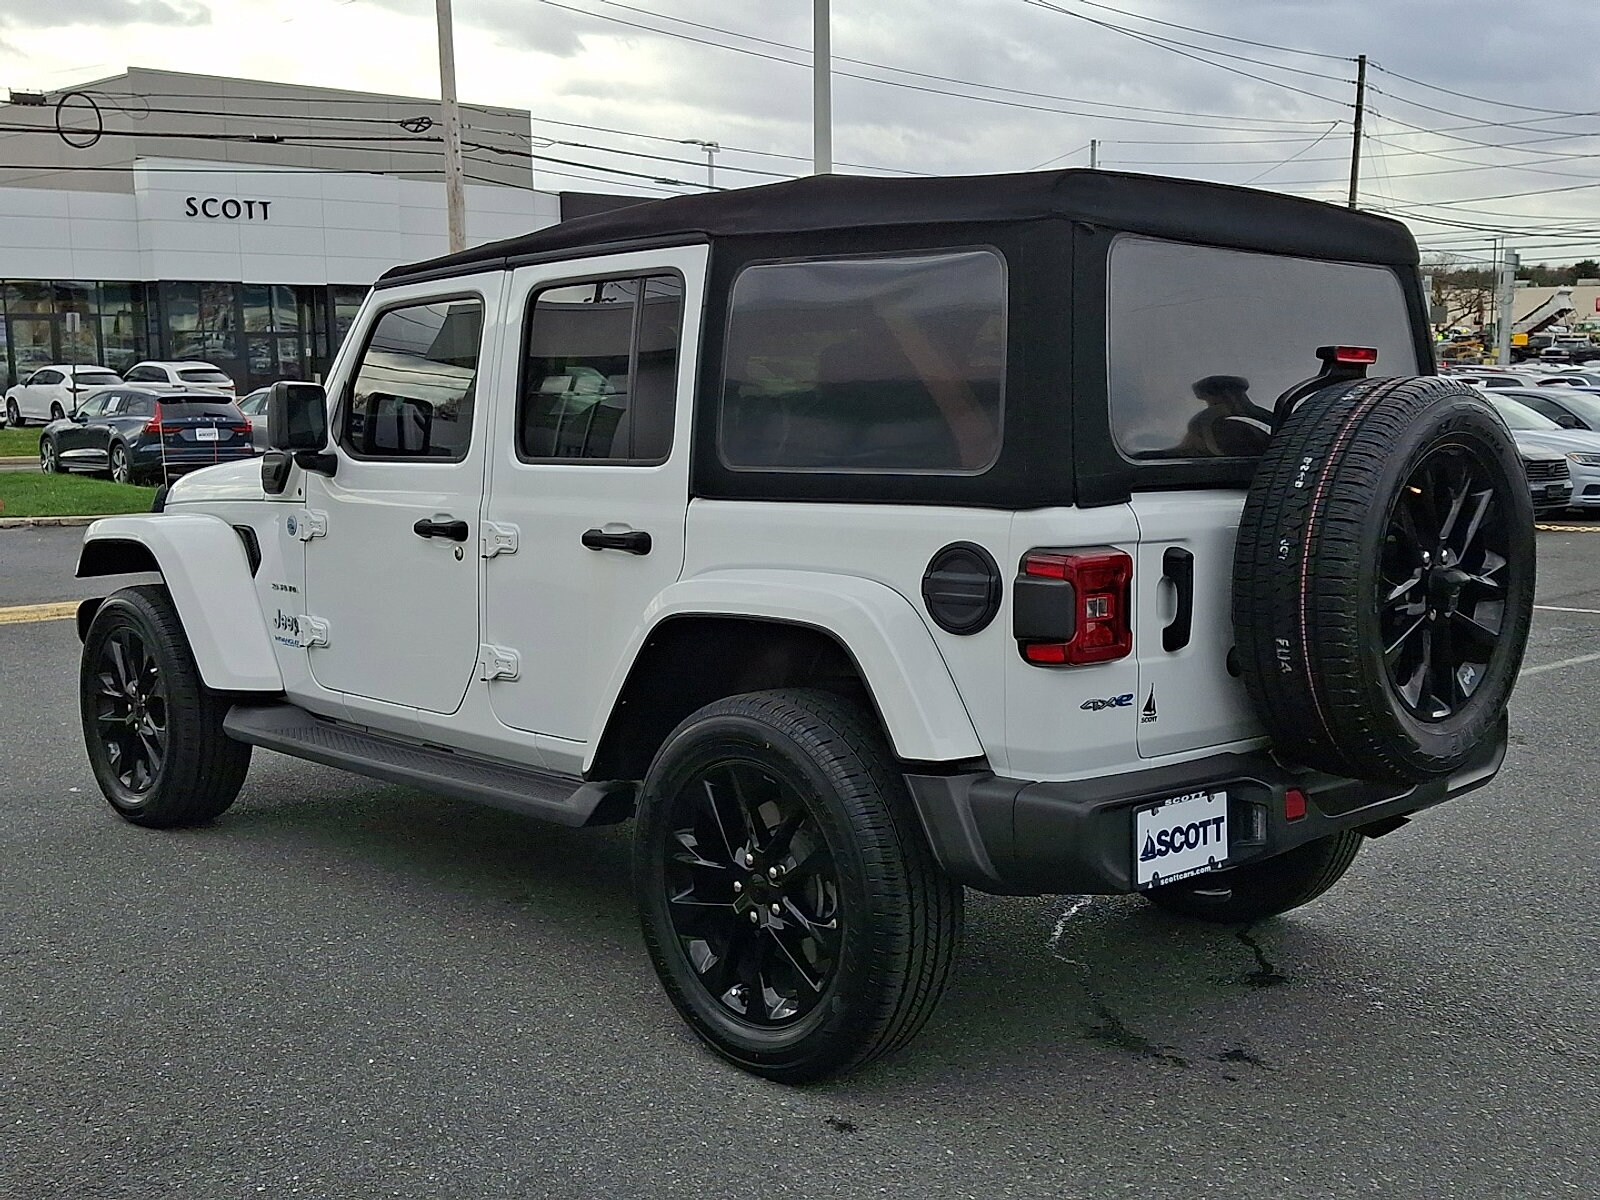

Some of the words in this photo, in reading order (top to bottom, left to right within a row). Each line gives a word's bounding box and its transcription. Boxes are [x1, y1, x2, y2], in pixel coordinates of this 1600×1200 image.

[185, 197, 272, 220] SCOTT
[274, 609, 299, 636] Jeep
[1164, 791, 1205, 806] SCOTT
[1156, 816, 1225, 857] SCOTT
[1160, 866, 1211, 885] scottcars.com
